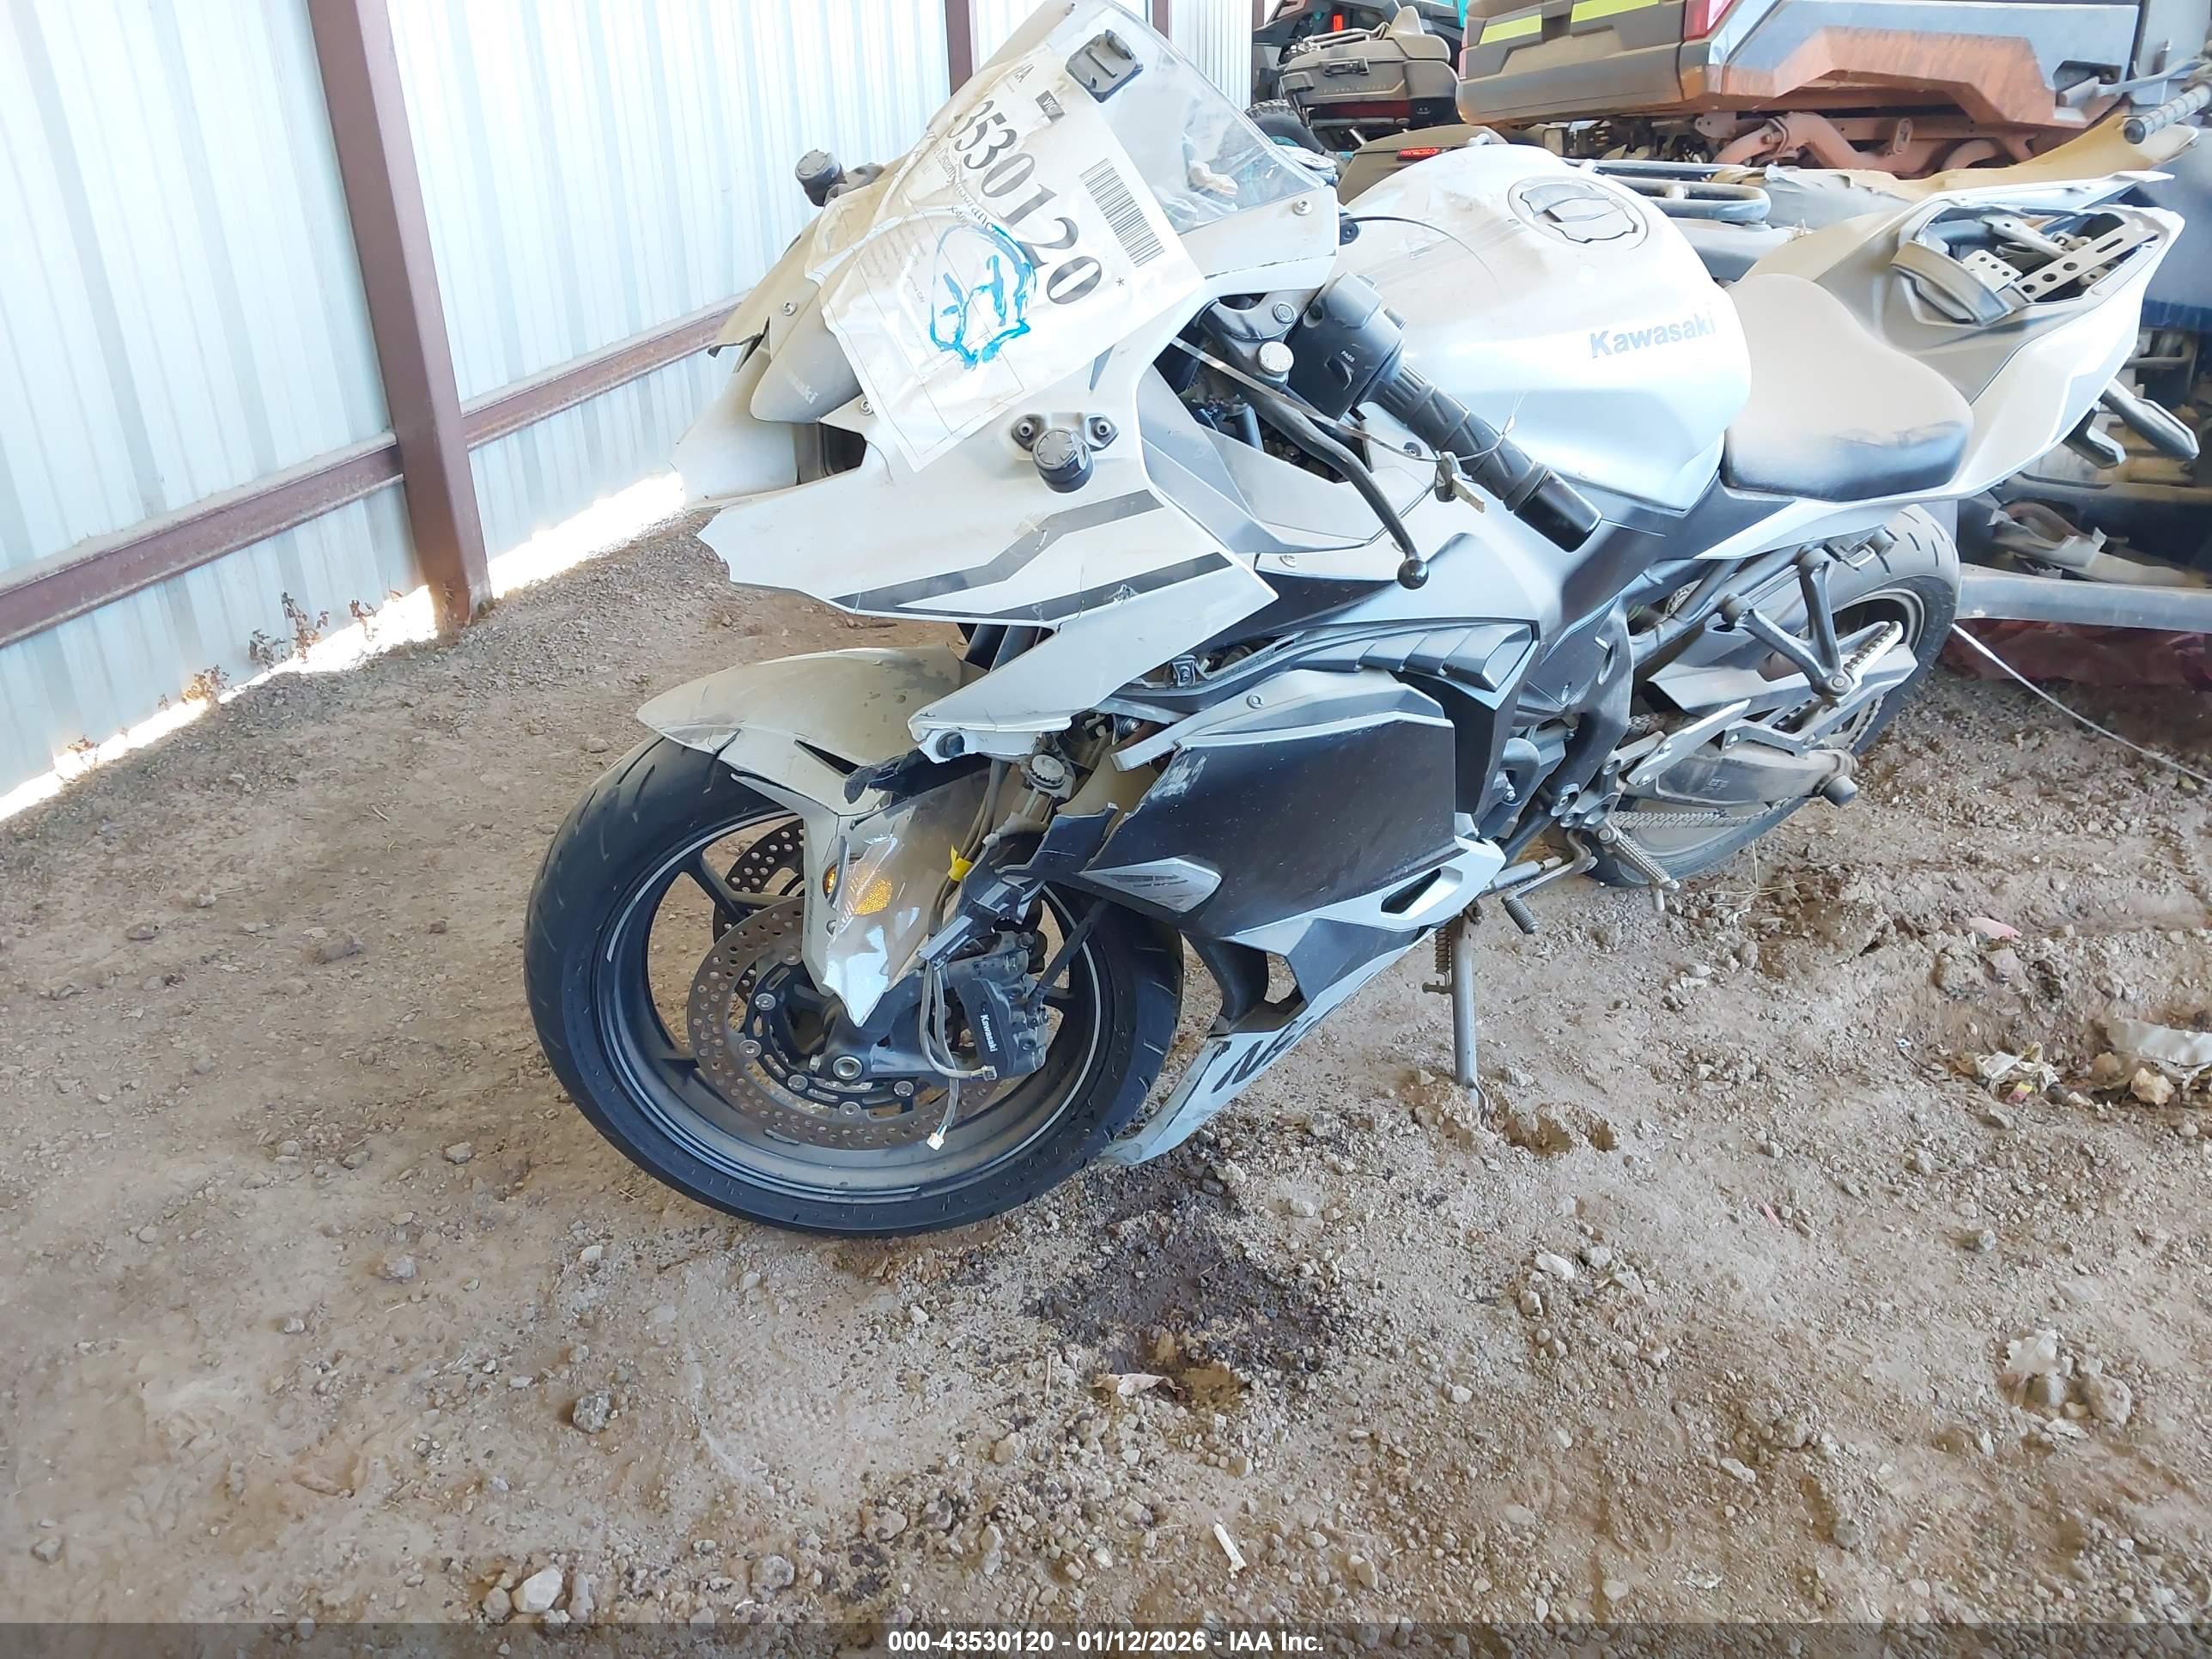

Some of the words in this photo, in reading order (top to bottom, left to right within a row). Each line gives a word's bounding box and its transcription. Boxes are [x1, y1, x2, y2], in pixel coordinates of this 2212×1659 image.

[946, 100, 1103, 305] 3530120
[1590, 311, 1716, 359] Kawasaki
[980, 1014, 998, 1052] Kawasaki
